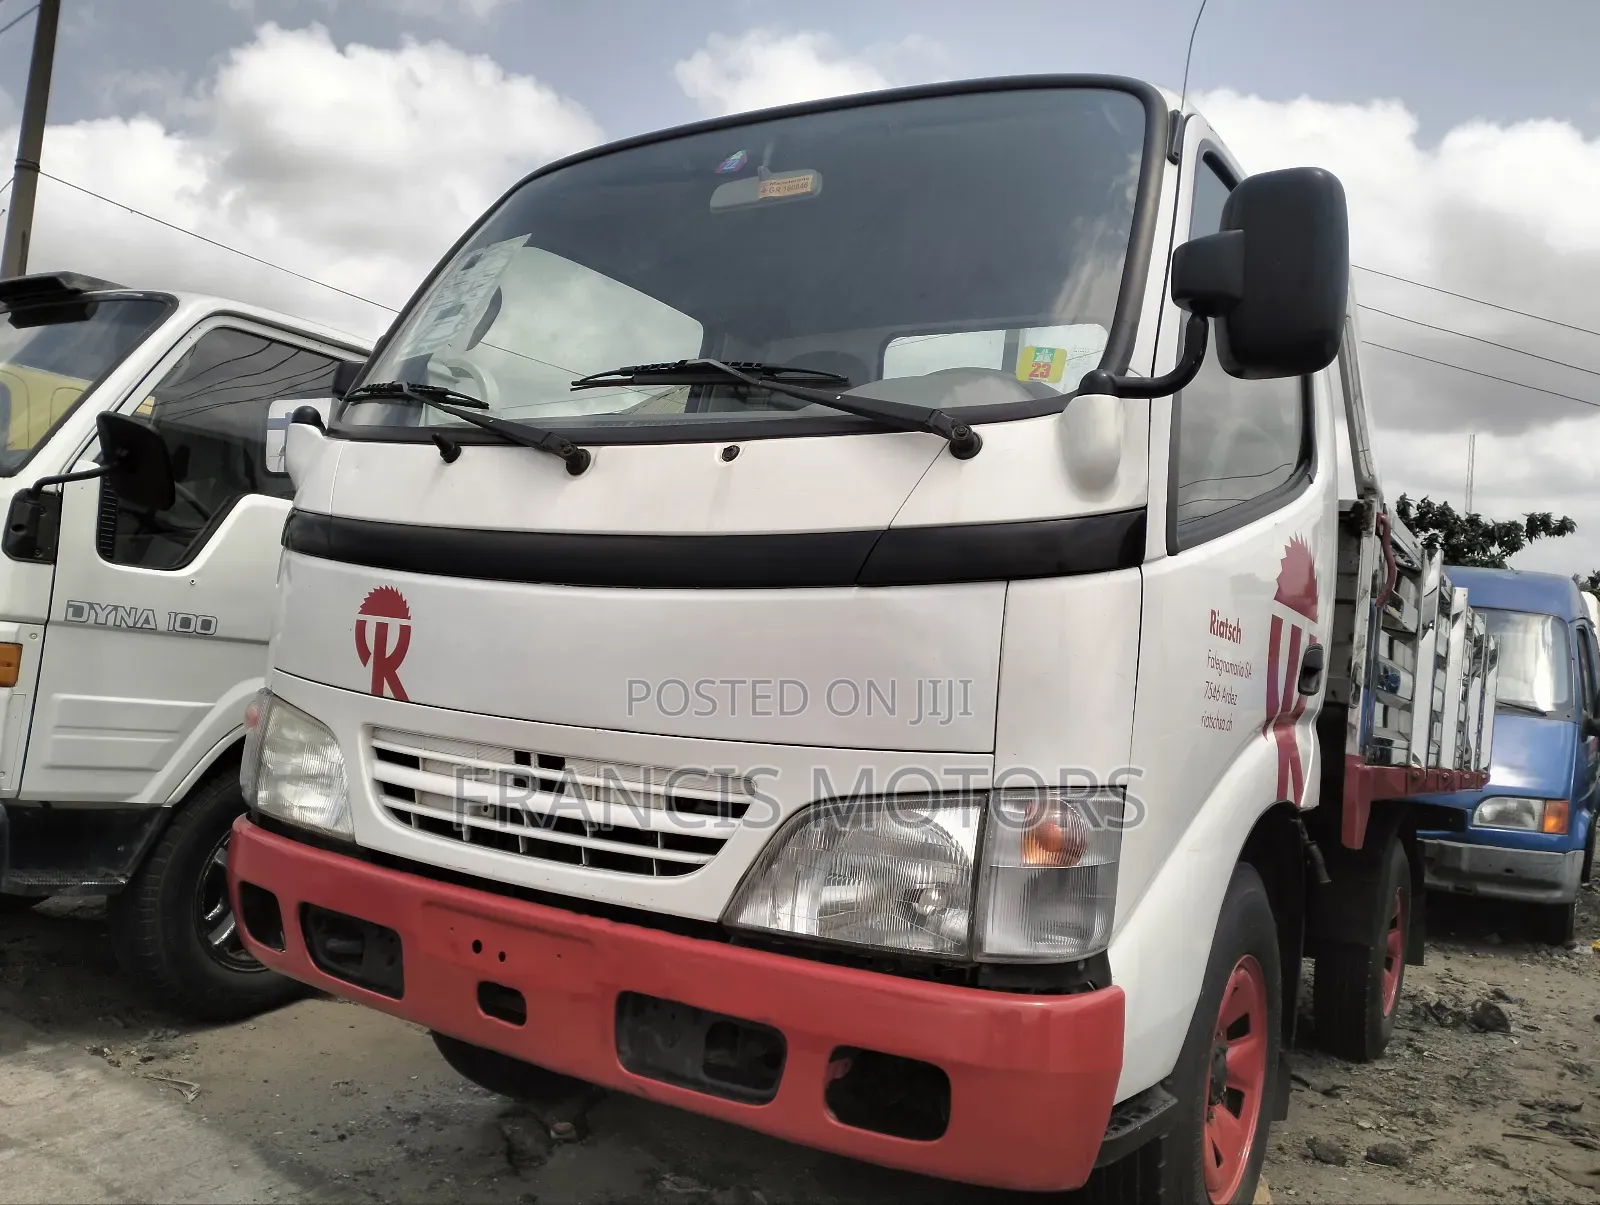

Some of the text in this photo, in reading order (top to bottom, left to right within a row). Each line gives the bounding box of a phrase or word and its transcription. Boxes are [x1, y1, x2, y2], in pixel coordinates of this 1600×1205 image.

[1029, 362, 1052, 378] 23
[64, 600, 218, 635] DYNA 100
[1209, 608, 1242, 644] Riatsch
[1204, 680, 1238, 706] 7546 Ardez
